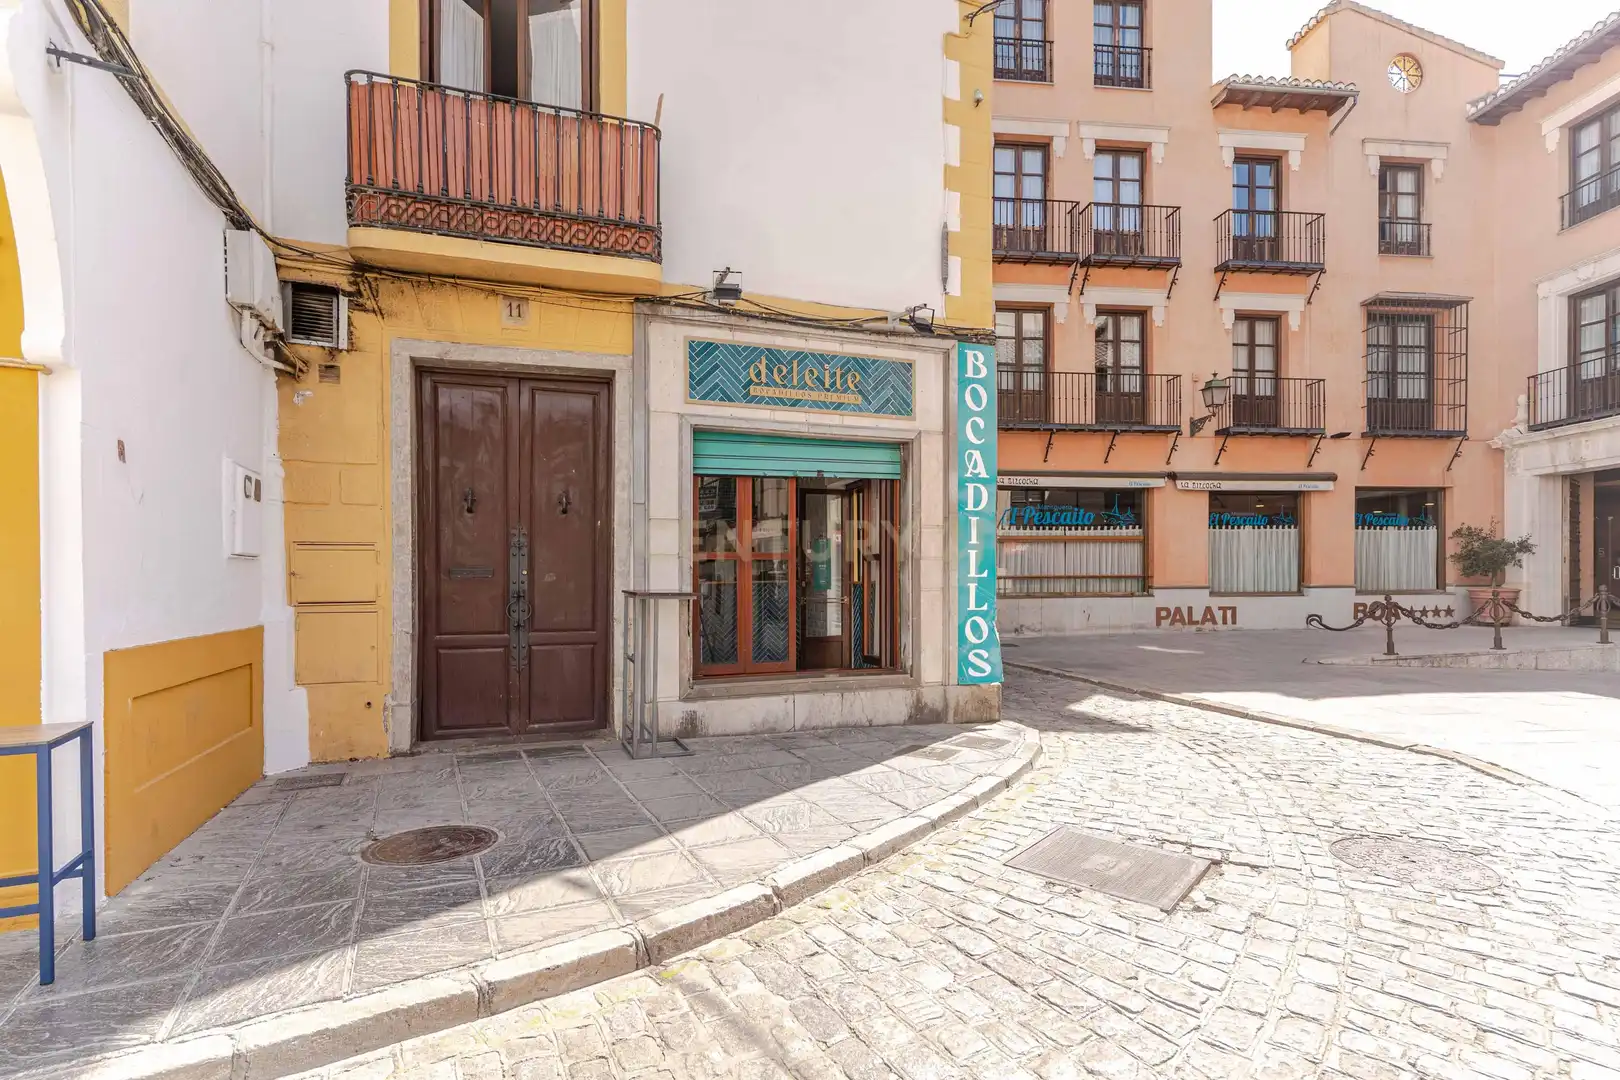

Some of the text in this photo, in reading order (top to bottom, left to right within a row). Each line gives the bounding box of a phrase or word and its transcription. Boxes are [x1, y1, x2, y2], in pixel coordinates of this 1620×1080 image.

[507, 301, 522, 318] 11
[749, 356, 861, 390] deleite
[752, 386, 812, 398] BOCADILLOS
[963, 349, 992, 677] BOCADILLOS
[1155, 605, 1238, 627] PALATI
